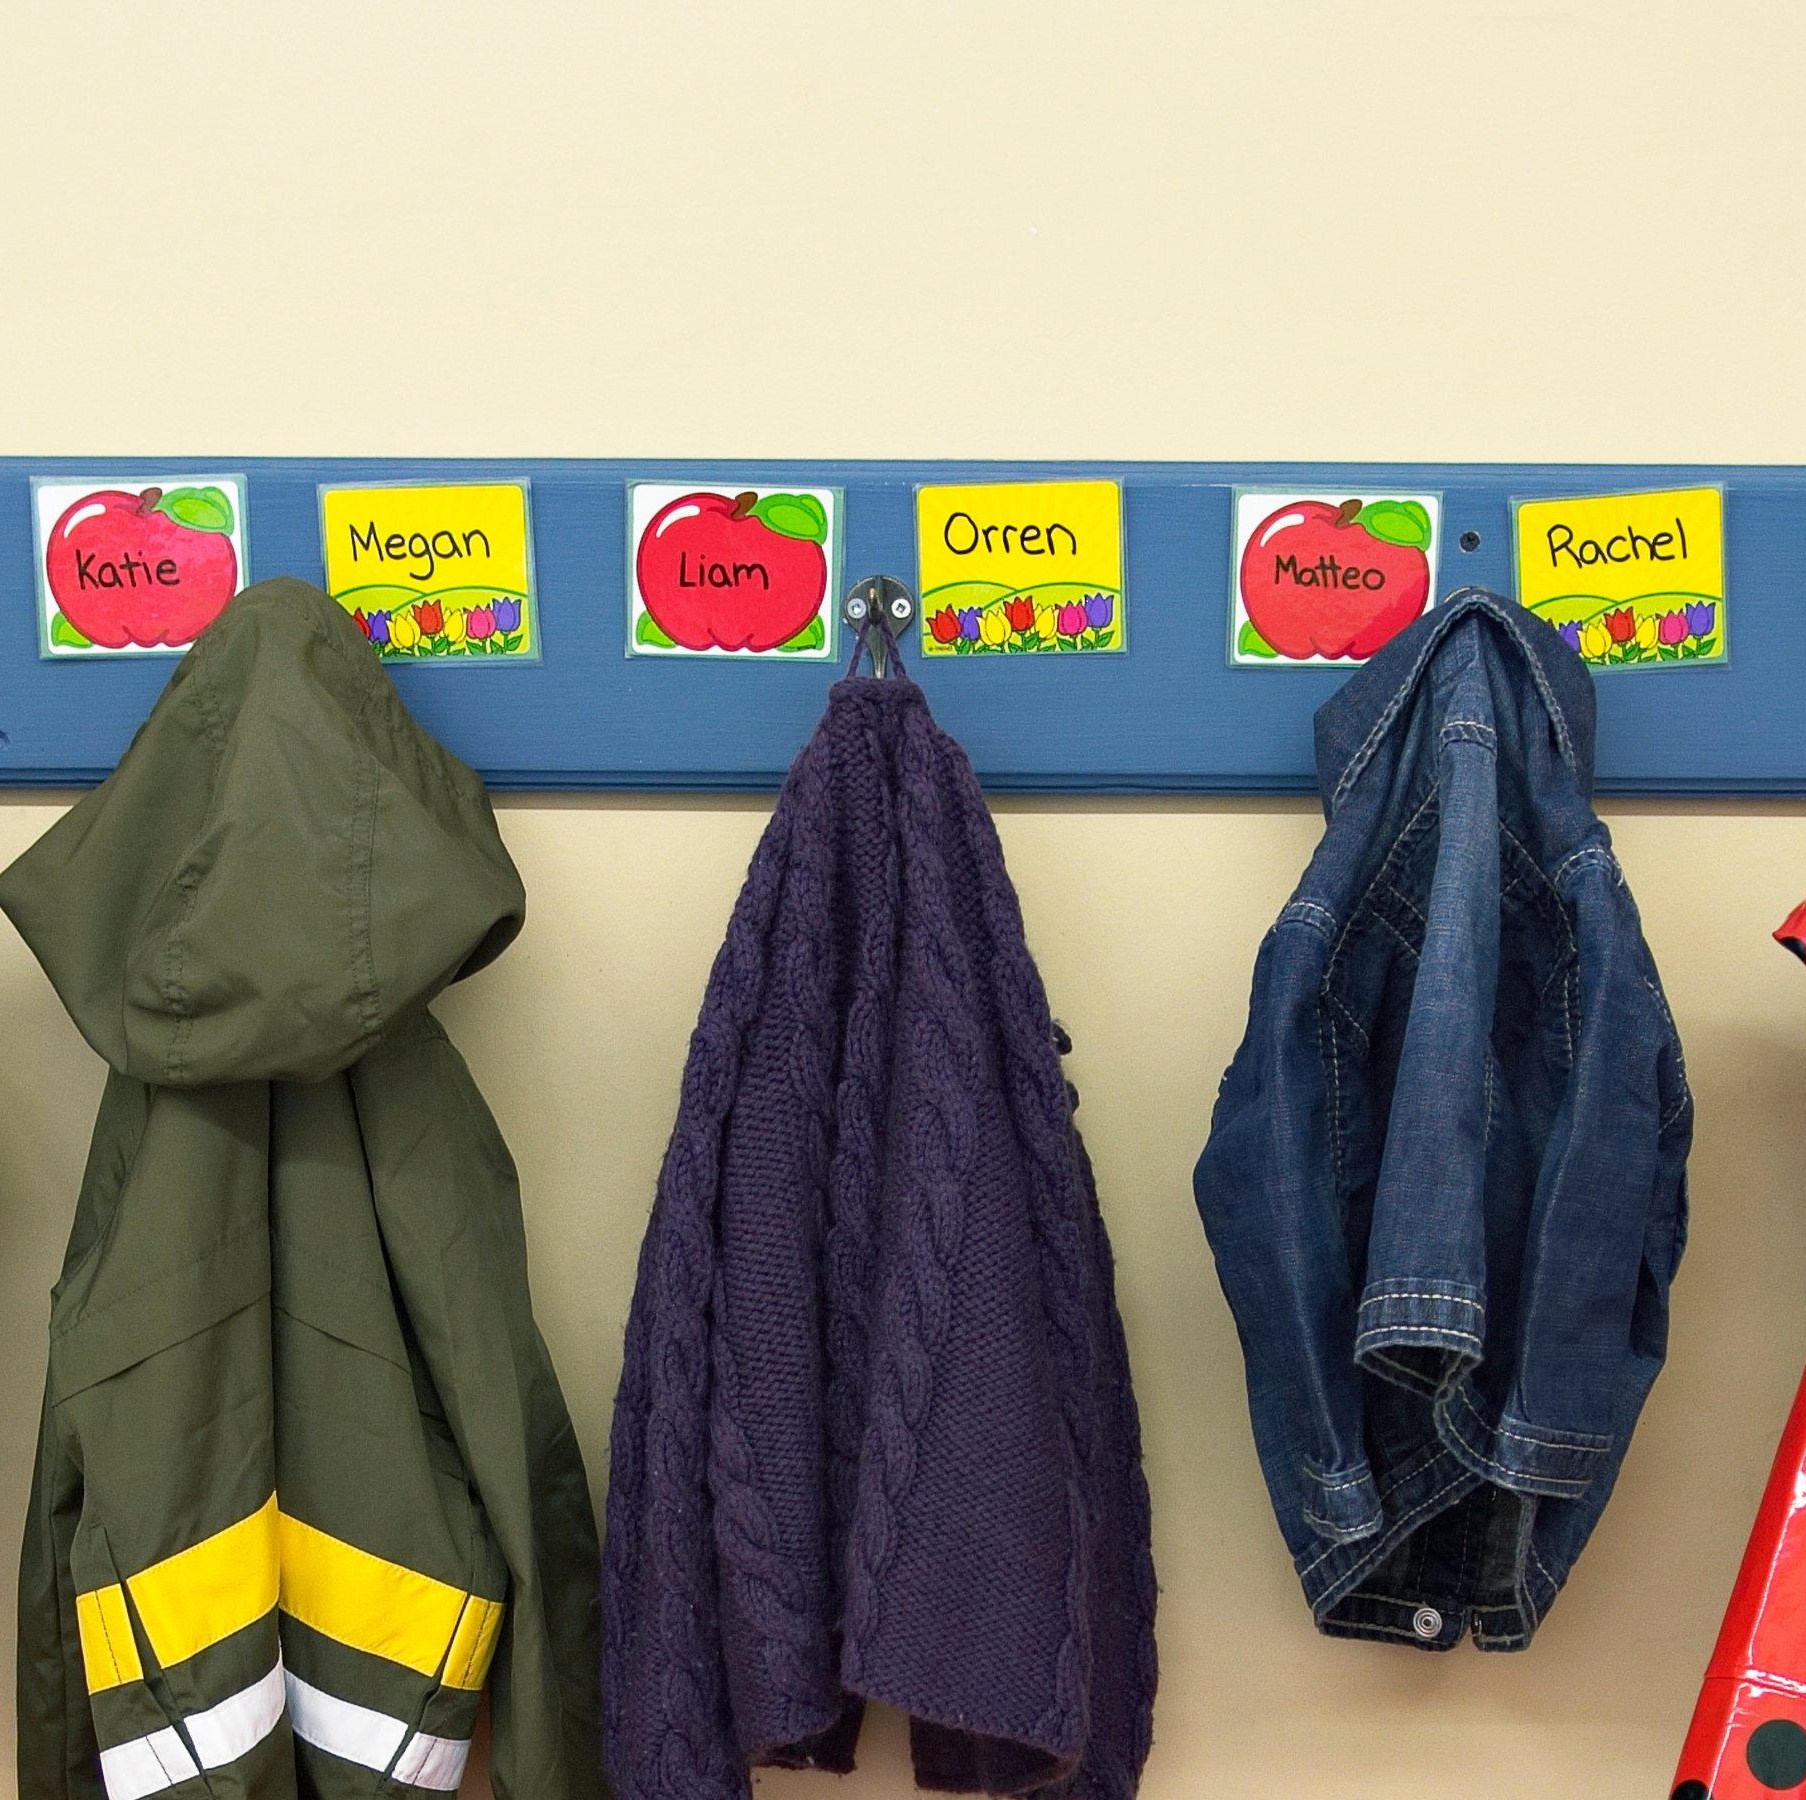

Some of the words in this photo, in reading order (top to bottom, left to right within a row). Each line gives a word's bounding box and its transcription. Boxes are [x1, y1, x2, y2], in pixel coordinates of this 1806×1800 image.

[349, 521, 490, 582] Megan
[944, 512, 1077, 555] Orren
[1547, 519, 1687, 569] Rachel
[75, 549, 180, 590] Katie
[679, 553, 769, 589] Liam
[1274, 555, 1386, 592] Matteo
